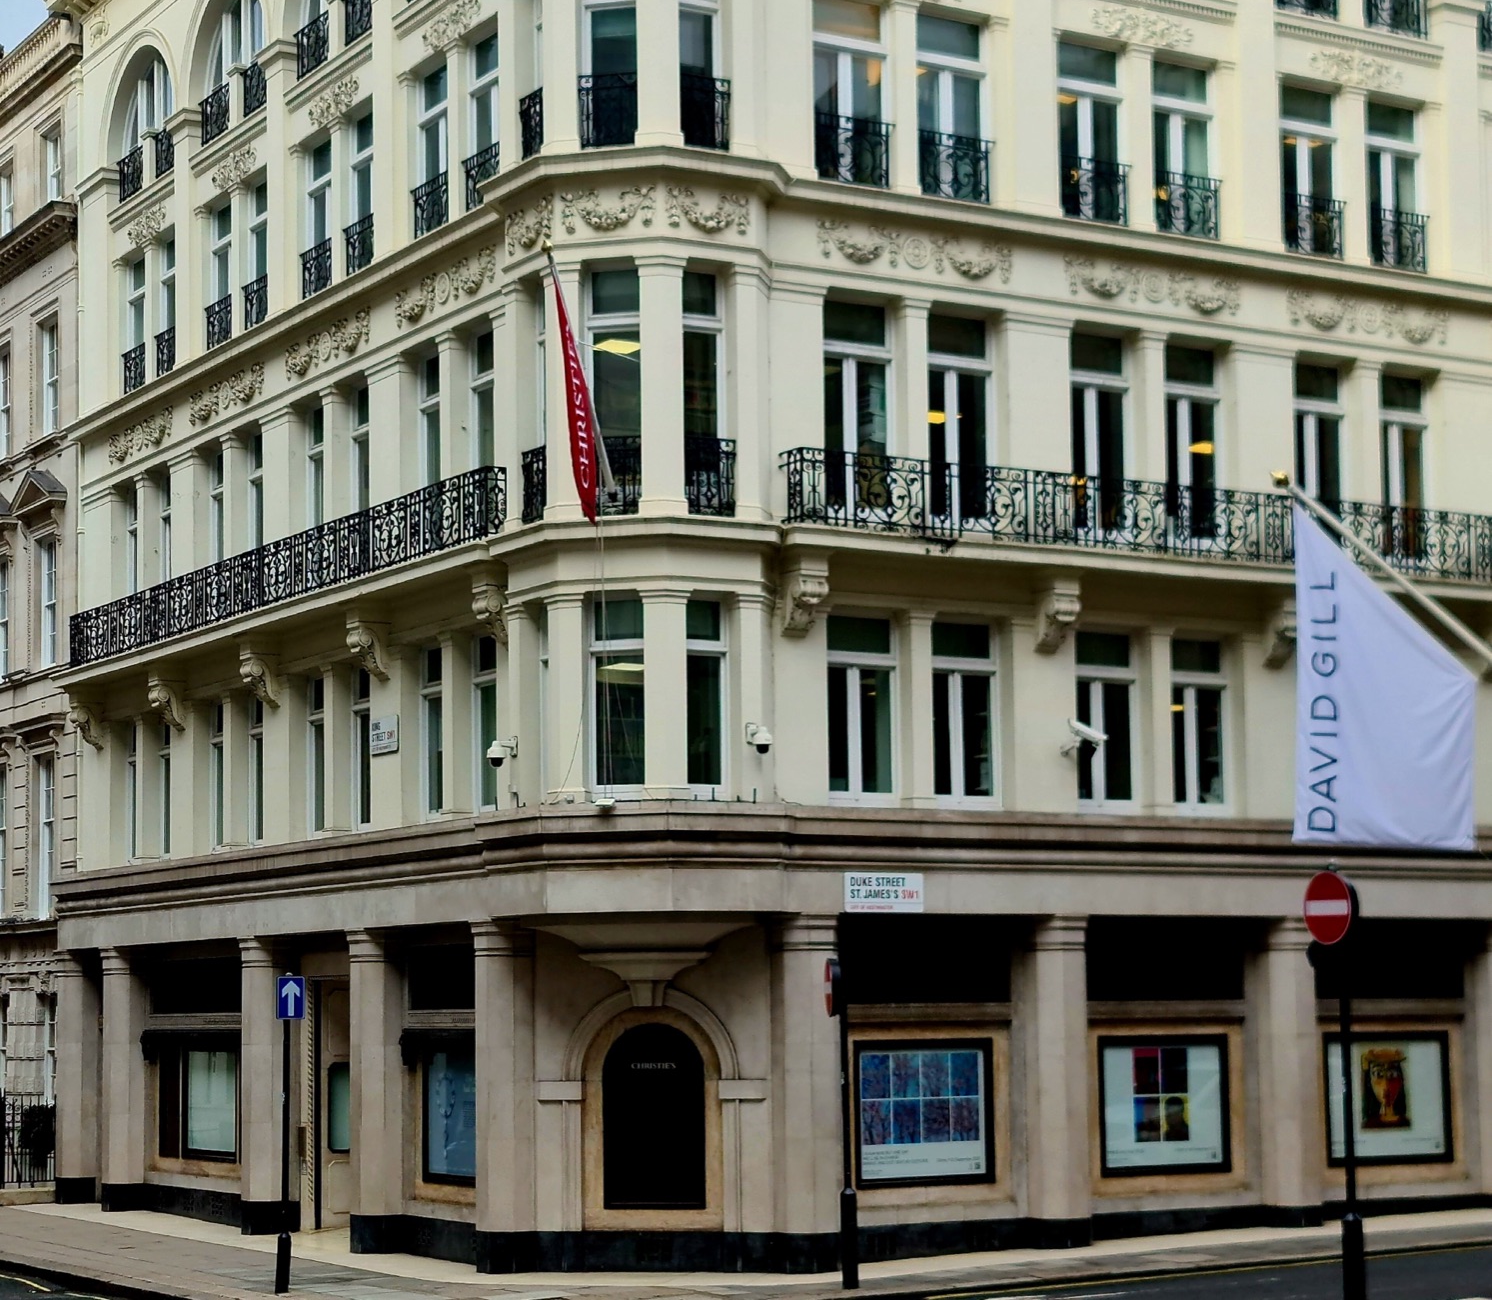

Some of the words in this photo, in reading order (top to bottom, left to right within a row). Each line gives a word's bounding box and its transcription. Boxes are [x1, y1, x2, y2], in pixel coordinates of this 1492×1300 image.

[1309, 571, 1338, 678] GILL
[1307, 695, 1338, 833] DAVID
[850, 876, 873, 887] DUKE
[875, 877, 906, 887] STREET
[901, 889, 919, 900] SW1
